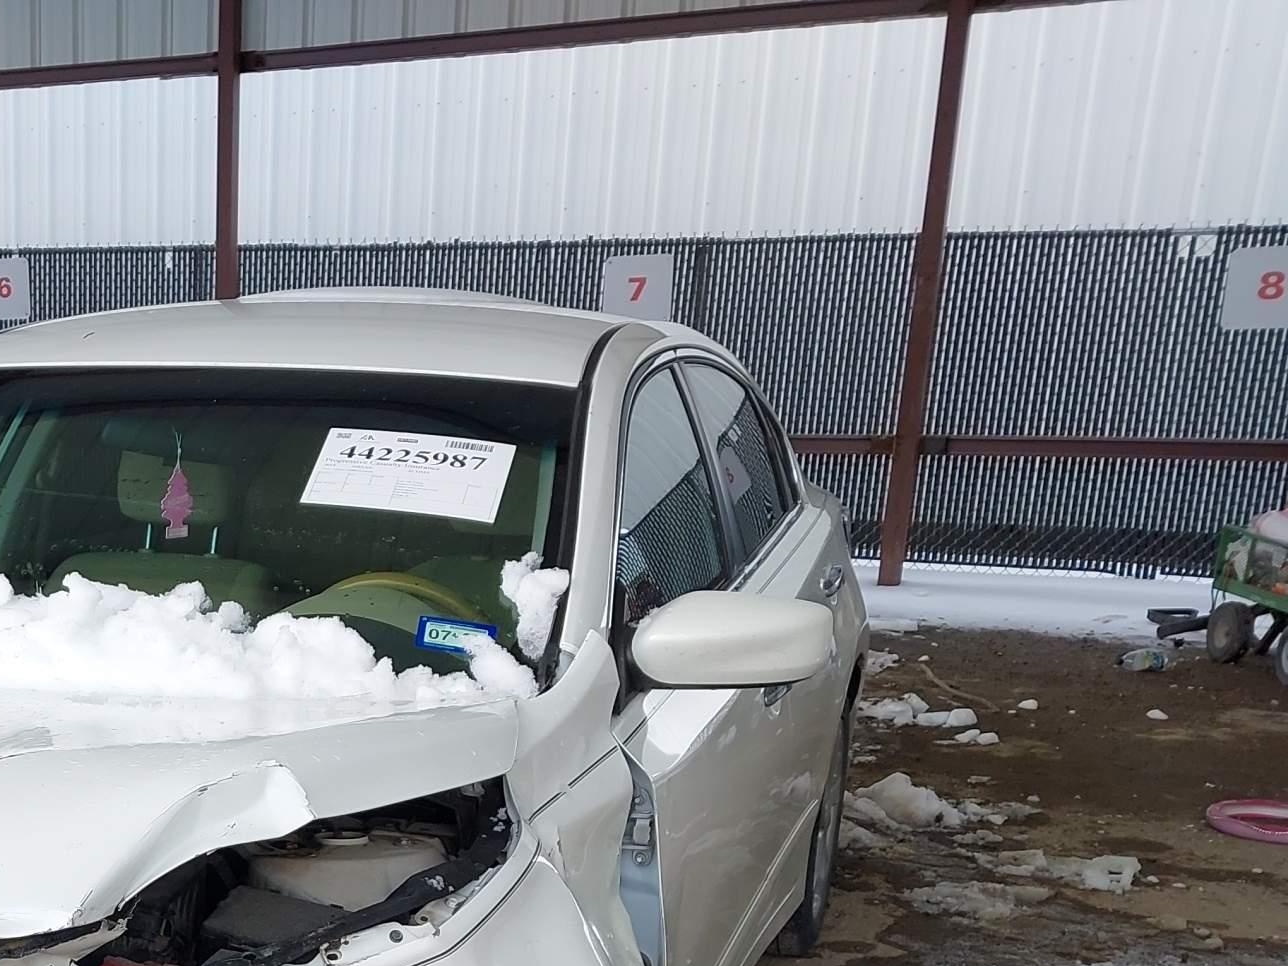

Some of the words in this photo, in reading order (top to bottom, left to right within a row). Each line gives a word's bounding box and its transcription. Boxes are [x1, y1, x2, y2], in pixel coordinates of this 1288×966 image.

[628, 276, 648, 302] 7
[1257, 271, 1286, 300] 8
[339, 445, 488, 470] 44225987
